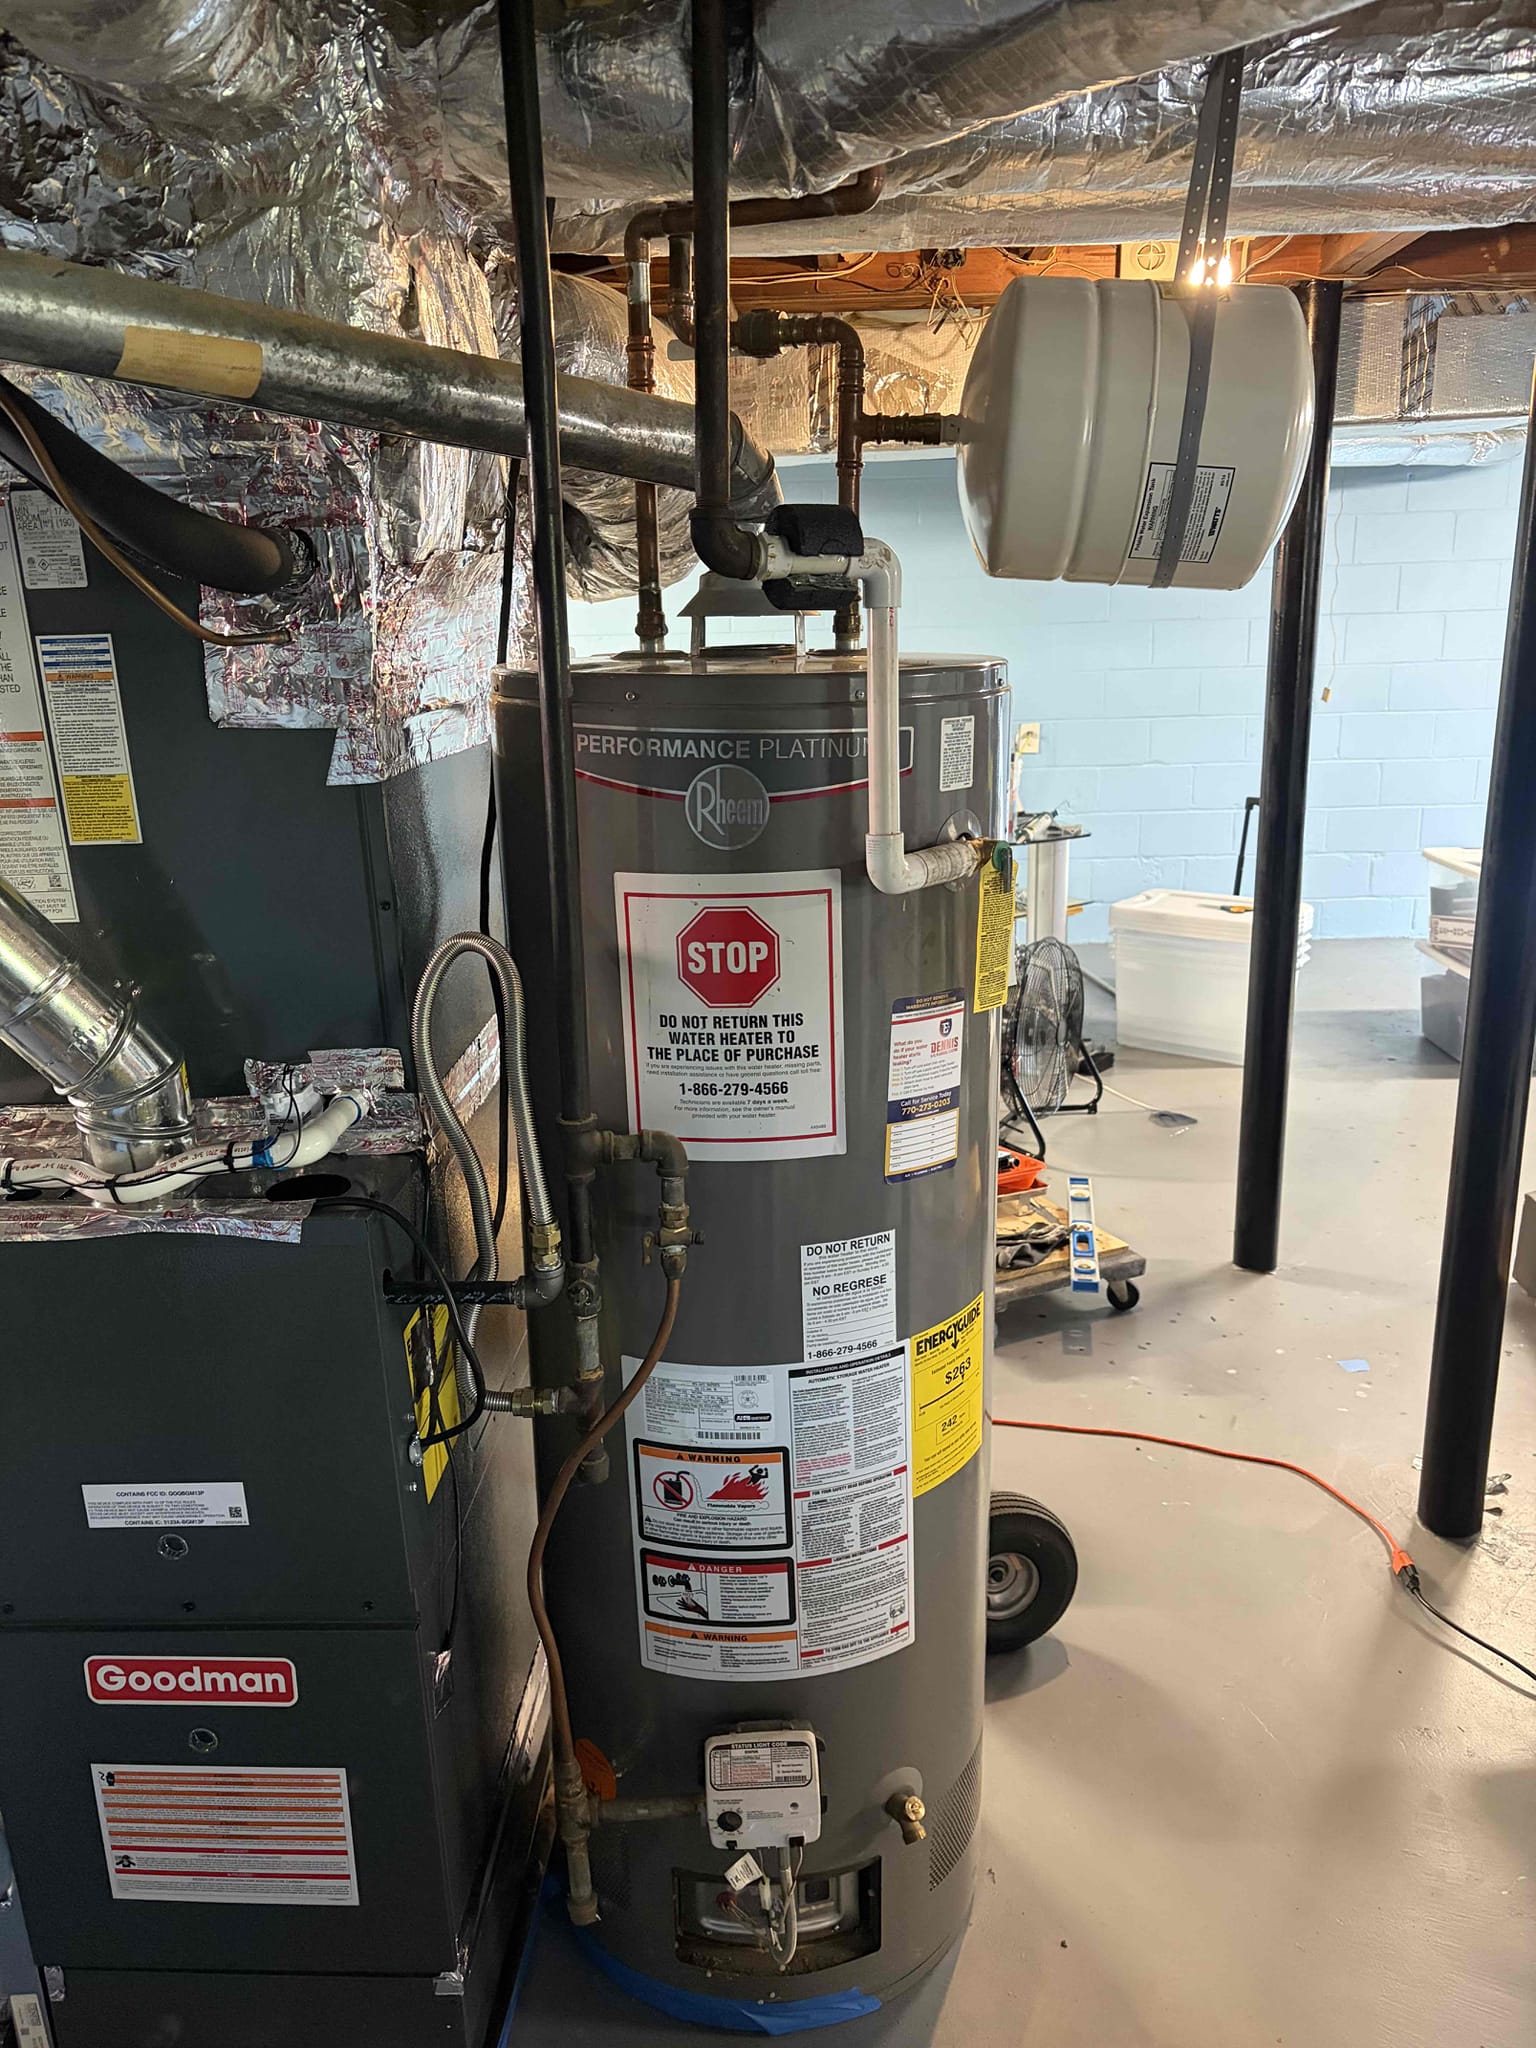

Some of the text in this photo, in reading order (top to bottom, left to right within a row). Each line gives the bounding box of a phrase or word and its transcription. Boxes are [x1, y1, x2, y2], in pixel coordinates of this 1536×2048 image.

[577, 734, 868, 759] PERFORMANCE PLATINU
[698, 768, 763, 836] Rheem
[687, 941, 768, 974] STOP
[660, 1013, 804, 1029] DO NOT RETURN THIS
[669, 1030, 795, 1045] WATER HEATER TO
[931, 1037, 958, 1053] DENNIS
[647, 1045, 819, 1062] THE PLACE OF PURCHASE
[679, 1081, 788, 1096] 1-866-279-4566
[806, 1233, 890, 1256] DO NOT RETURN
[813, 1274, 887, 1296] NO REGRESE
[916, 1302, 980, 1356] ENERGYGUIDE
[808, 1340, 877, 1359] 1-866-279-4566
[941, 1414, 957, 1432] 242
[688, 1455, 741, 1463] WARNING
[699, 1564, 742, 1573] DANGER
[703, 1634, 748, 1642] WARNING
[96, 1665, 286, 1693] Goodman
